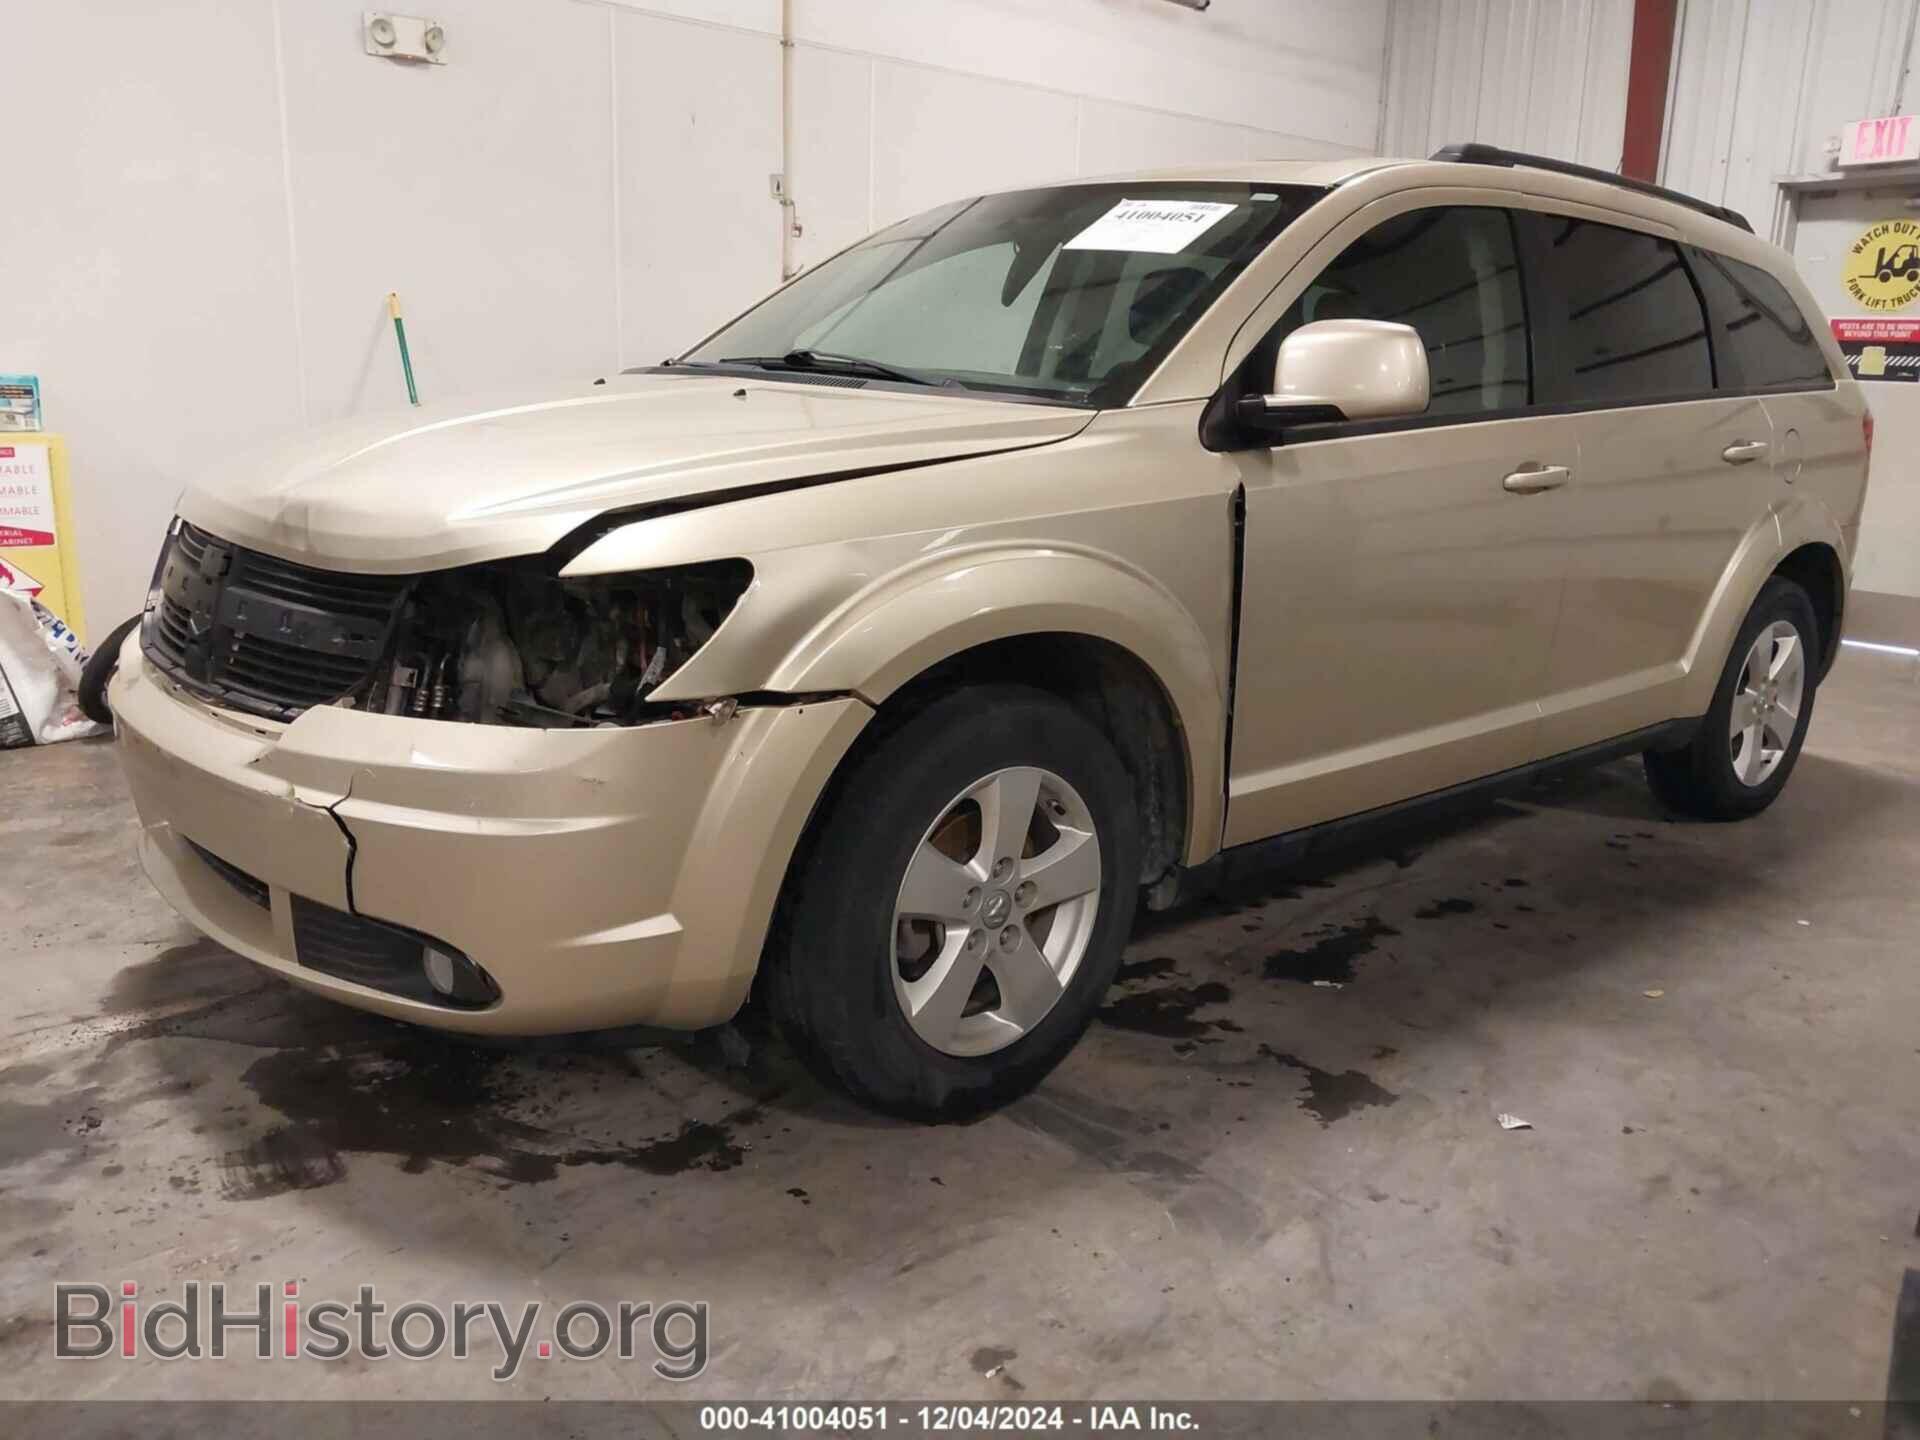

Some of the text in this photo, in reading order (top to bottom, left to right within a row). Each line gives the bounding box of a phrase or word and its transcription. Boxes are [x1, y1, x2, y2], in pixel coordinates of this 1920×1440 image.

[1854, 115, 1912, 159] EXIT
[1852, 222, 1918, 254] WATCH OUT
[1847, 278, 1920, 308] FORK LIFT TRUCK
